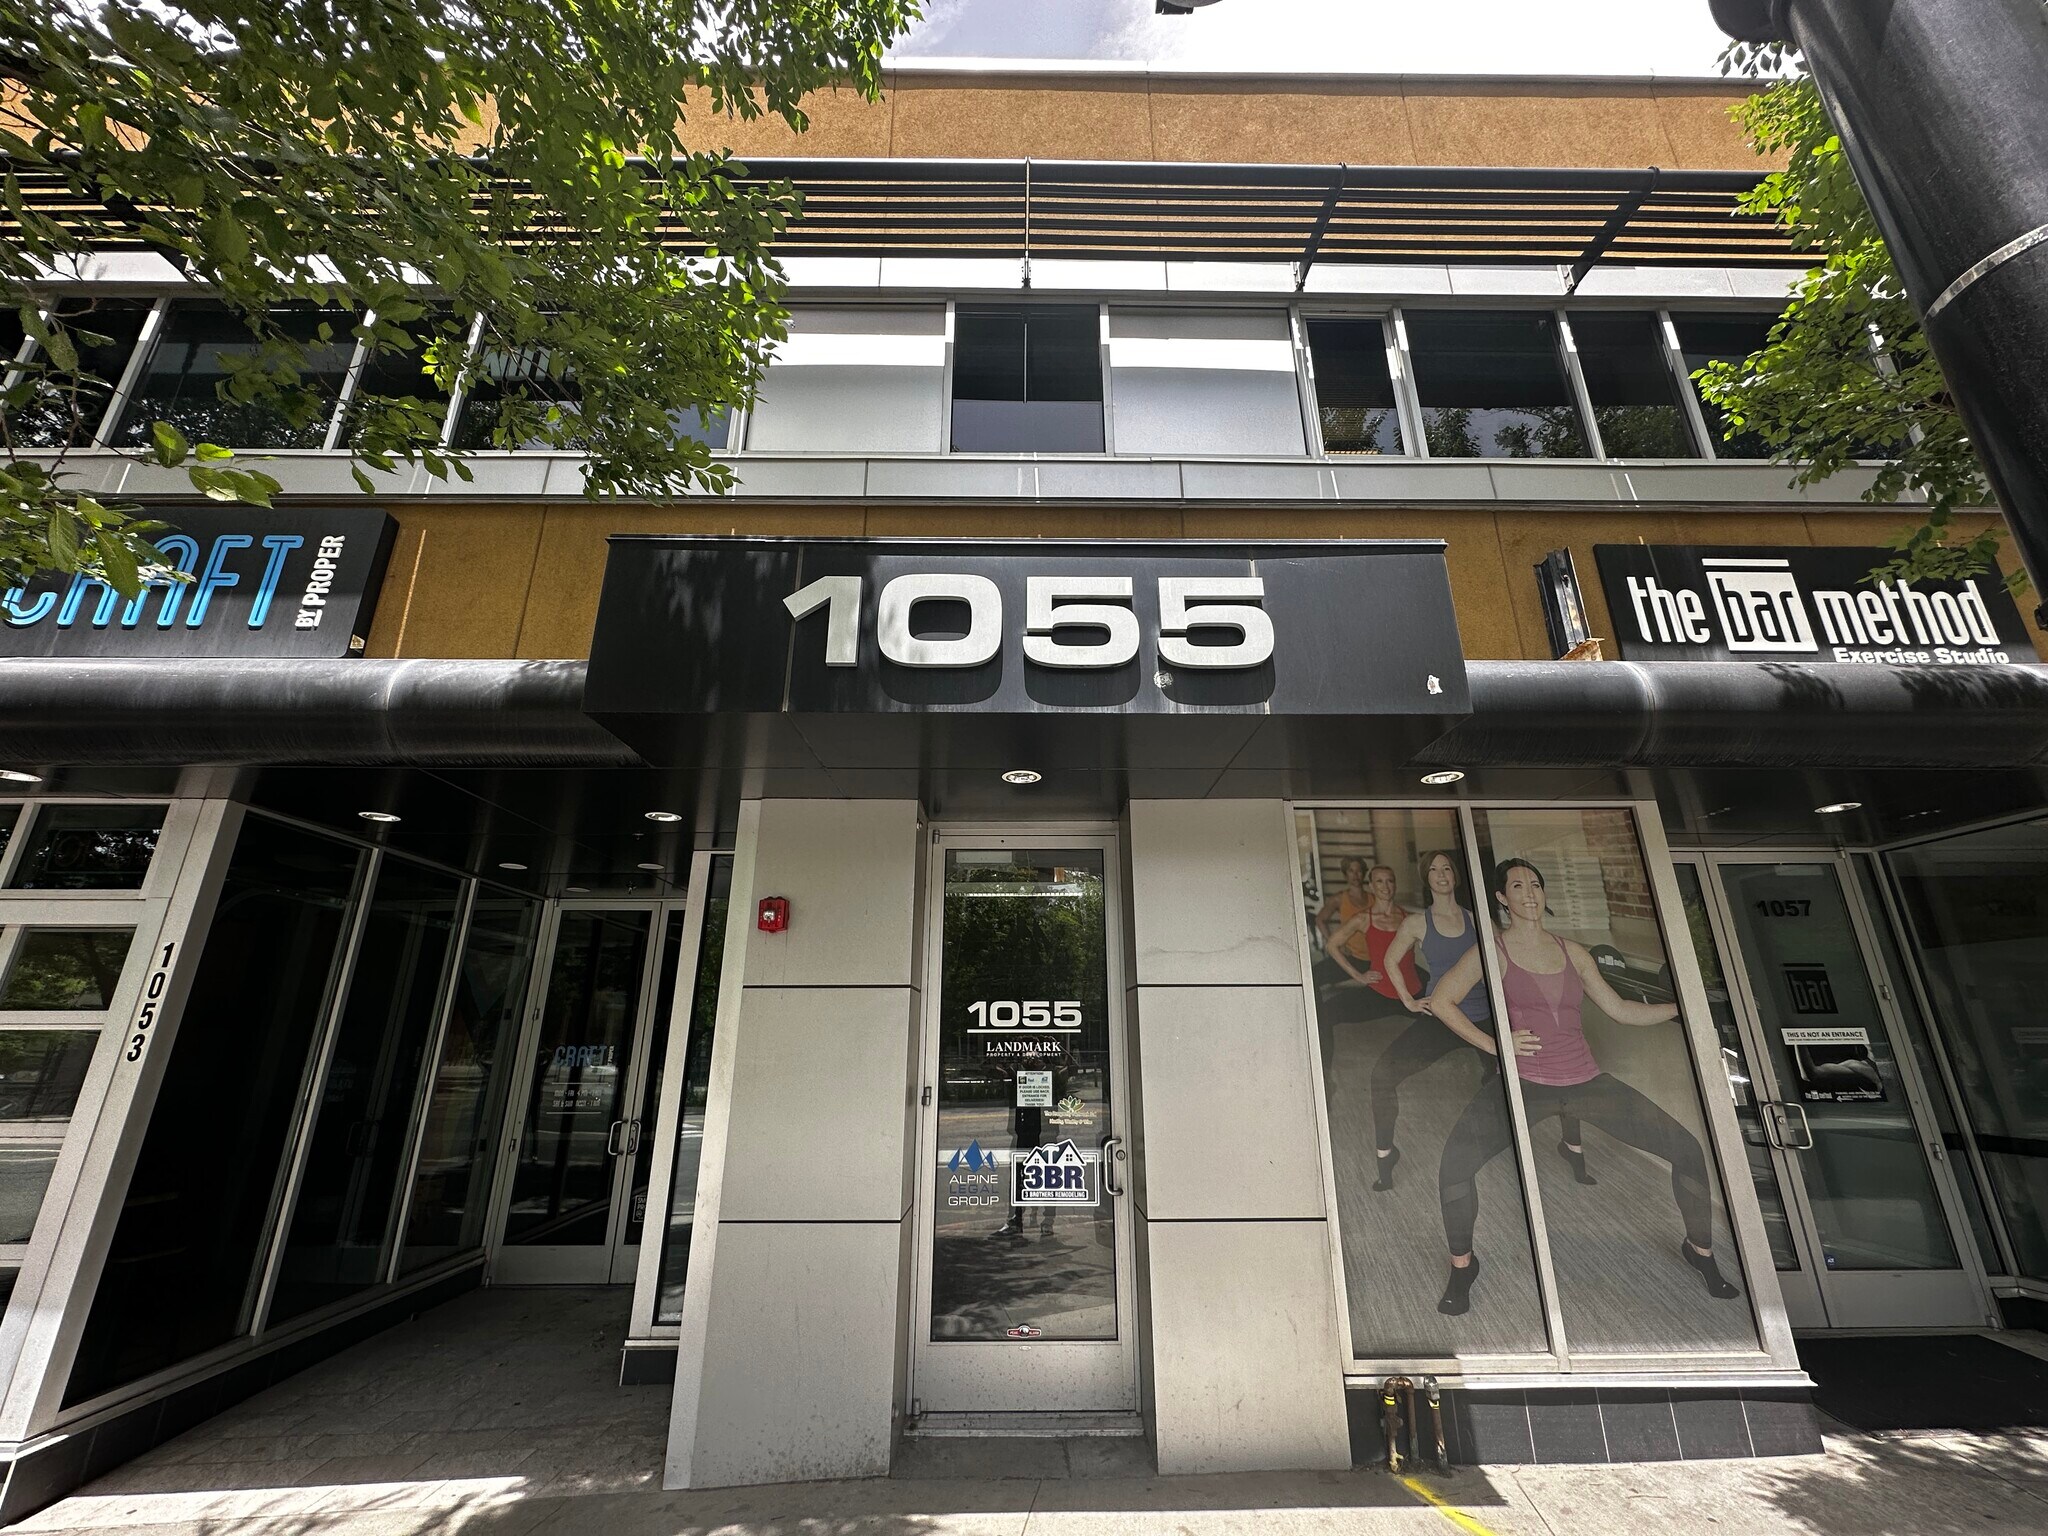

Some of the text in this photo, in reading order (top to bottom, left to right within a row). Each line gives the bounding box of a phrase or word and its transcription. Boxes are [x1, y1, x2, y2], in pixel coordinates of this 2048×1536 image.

[294, 535, 346, 628] BY PROPER
[782, 573, 1275, 670] 1055
[1626, 575, 2001, 646] the bar method
[1832, 646, 2010, 664] Exercise Studio
[1756, 899, 1812, 918] 1057
[126, 942, 176, 1062] 1053
[1789, 972, 1836, 1012] bar
[966, 1000, 1083, 1028] 1055
[553, 1045, 608, 1068] CRAFT
[986, 1041, 1062, 1052] LANDMARK
[949, 1174, 999, 1184] ALPINE
[949, 1184, 999, 1194] LEGAL
[1025, 1165, 1085, 1190] 3BR
[948, 1195, 1000, 1206] GROUP
